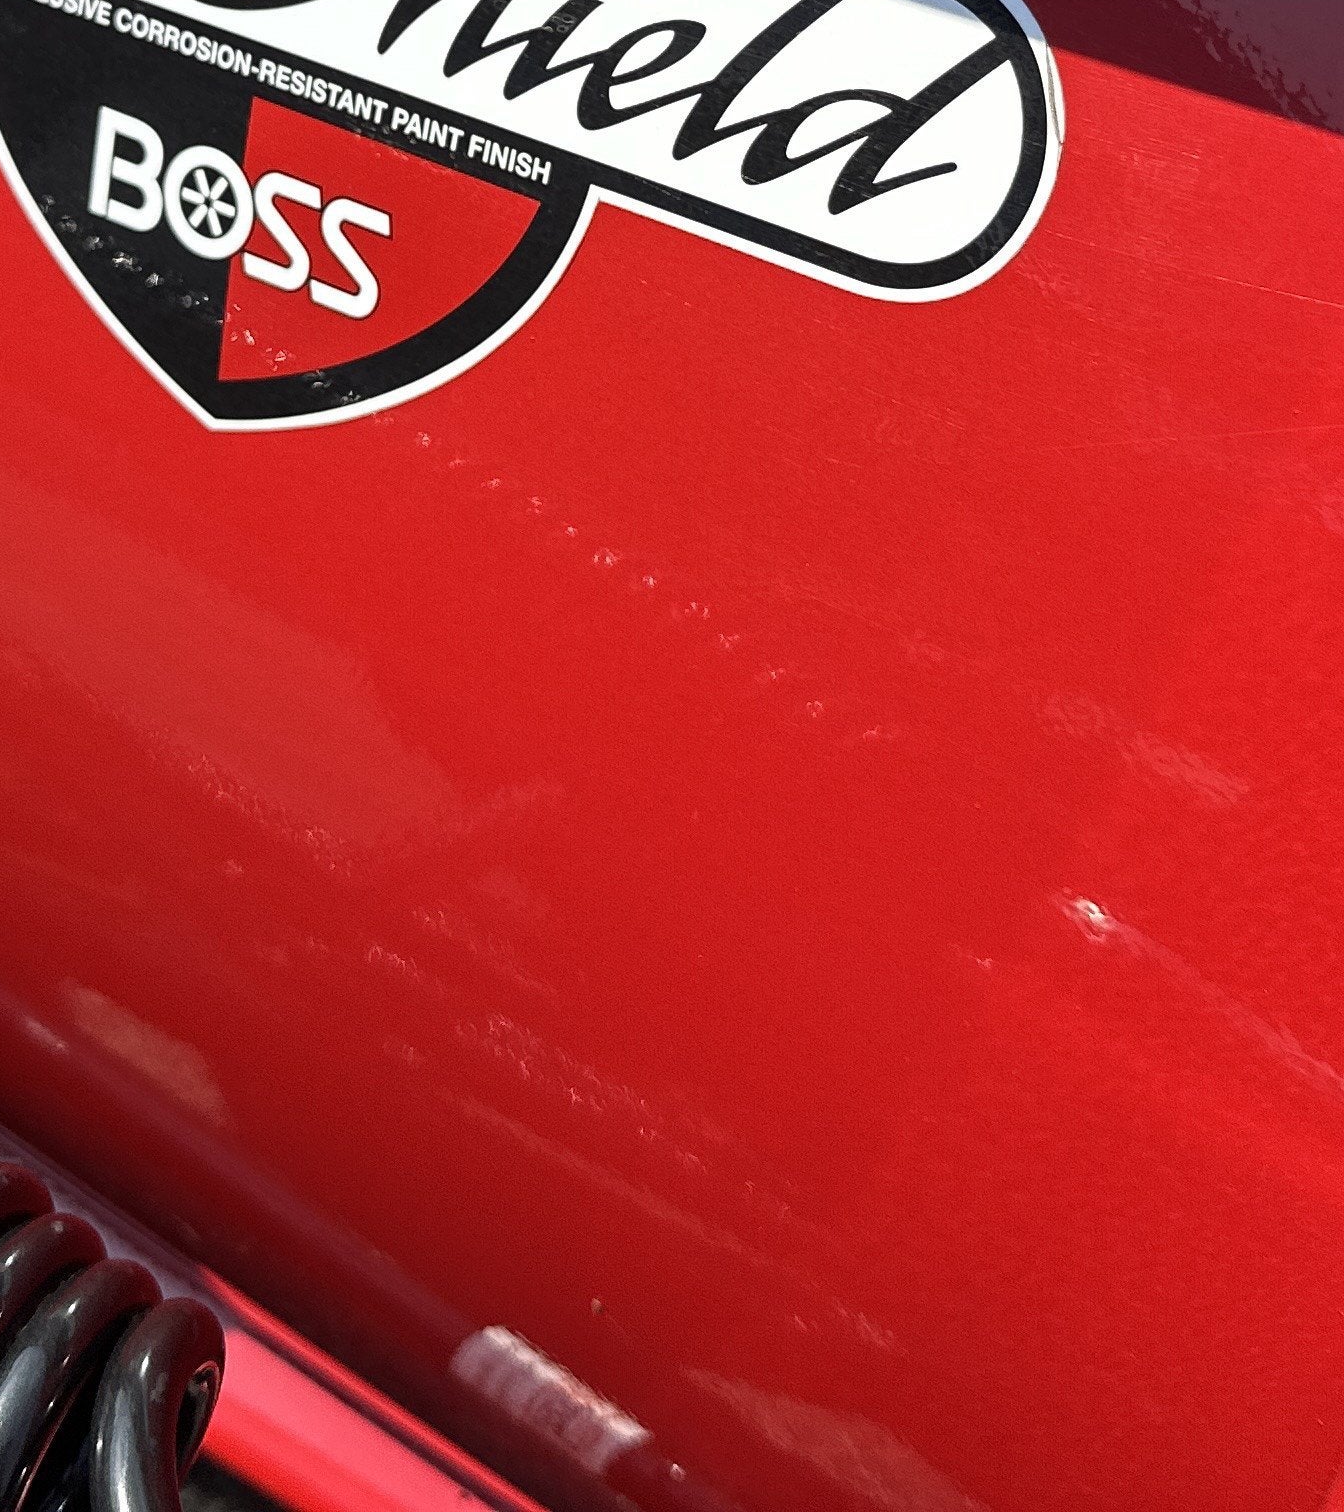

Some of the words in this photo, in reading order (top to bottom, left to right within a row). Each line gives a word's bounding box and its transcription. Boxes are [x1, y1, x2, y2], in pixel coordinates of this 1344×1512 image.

[113, 7, 389, 125] CORROSION-RESISTANT
[391, 106, 465, 152] PAINT
[467, 133, 553, 186] FINISH
[86, 105, 394, 321] BOSS
